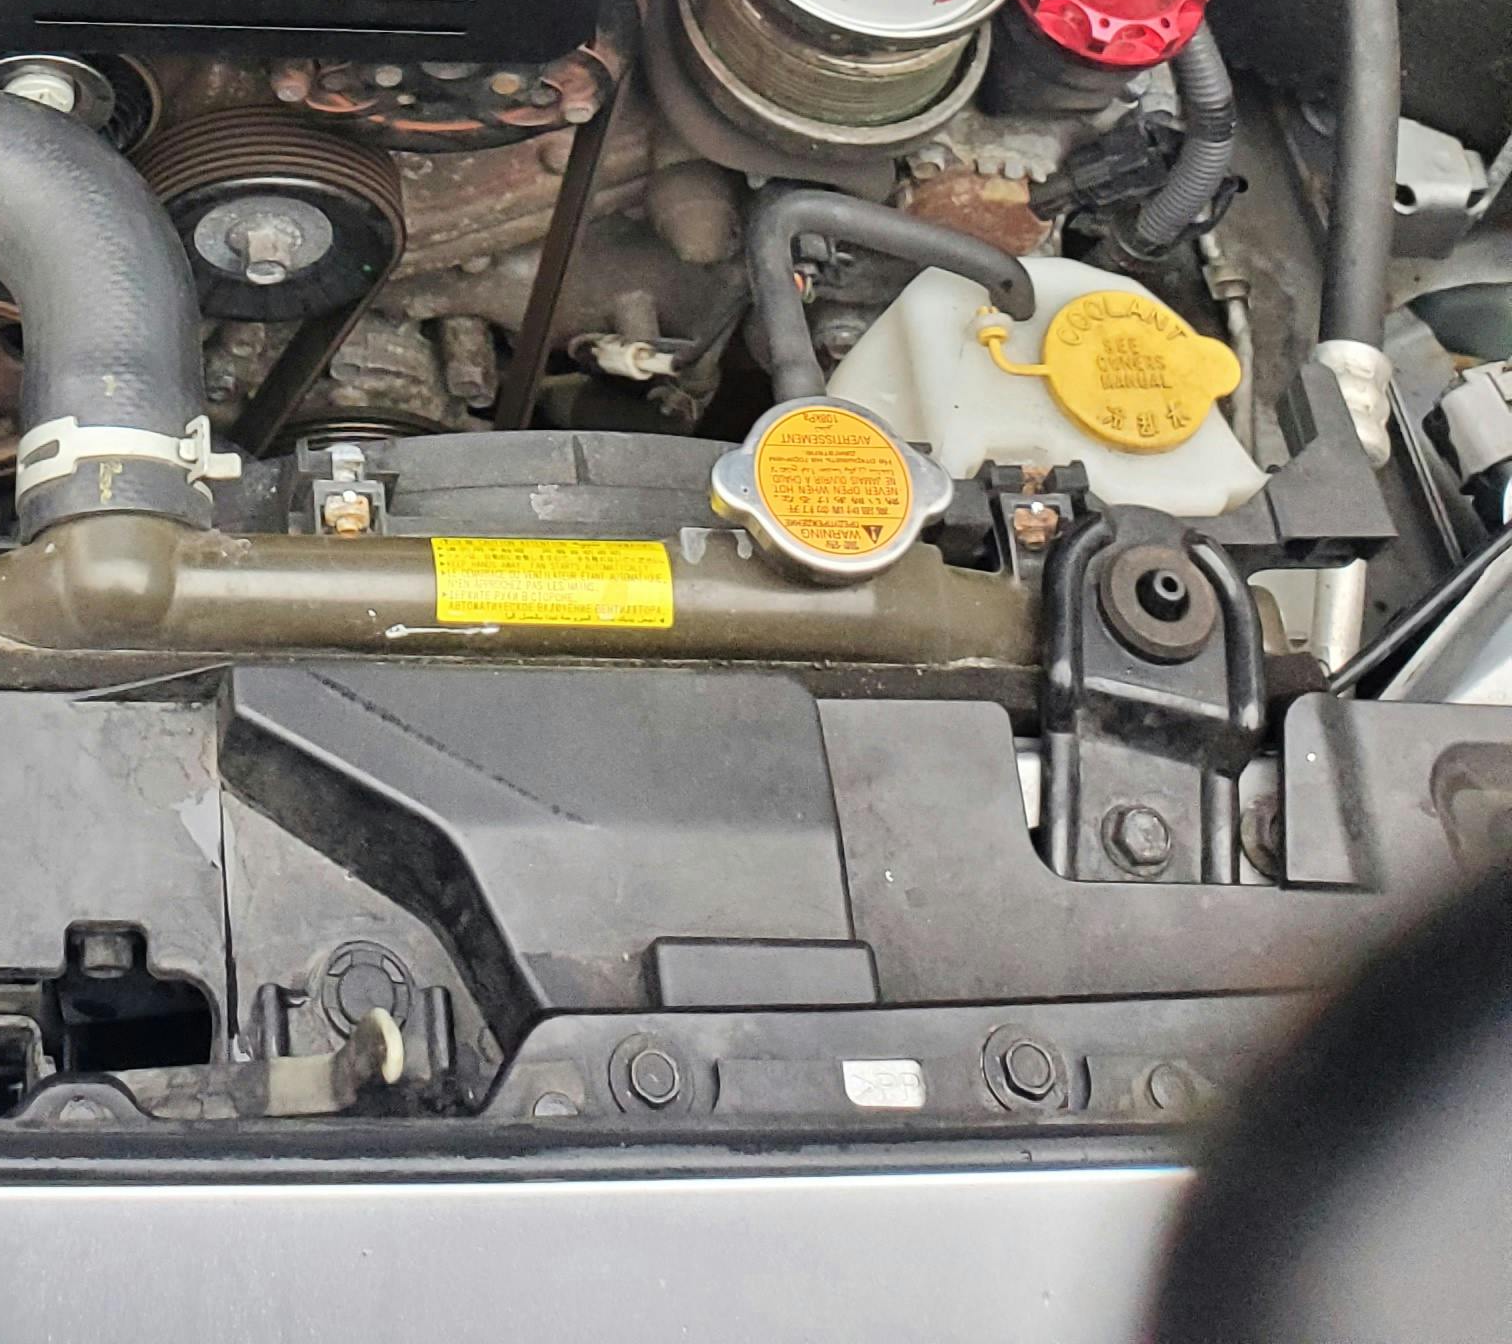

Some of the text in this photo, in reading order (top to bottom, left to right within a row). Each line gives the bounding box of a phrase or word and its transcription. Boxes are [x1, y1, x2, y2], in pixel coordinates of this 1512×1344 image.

[1057, 296, 1188, 346] COOLANT
[1101, 338, 1138, 355] SEE
[1099, 372, 1173, 390] MANUAL
[781, 433, 870, 444] AVERTISSEMENT
[798, 485, 829, 494] WHEN
[833, 486, 860, 495] OPEN
[864, 486, 899, 496] NEVER
[800, 529, 861, 539] WARNING
